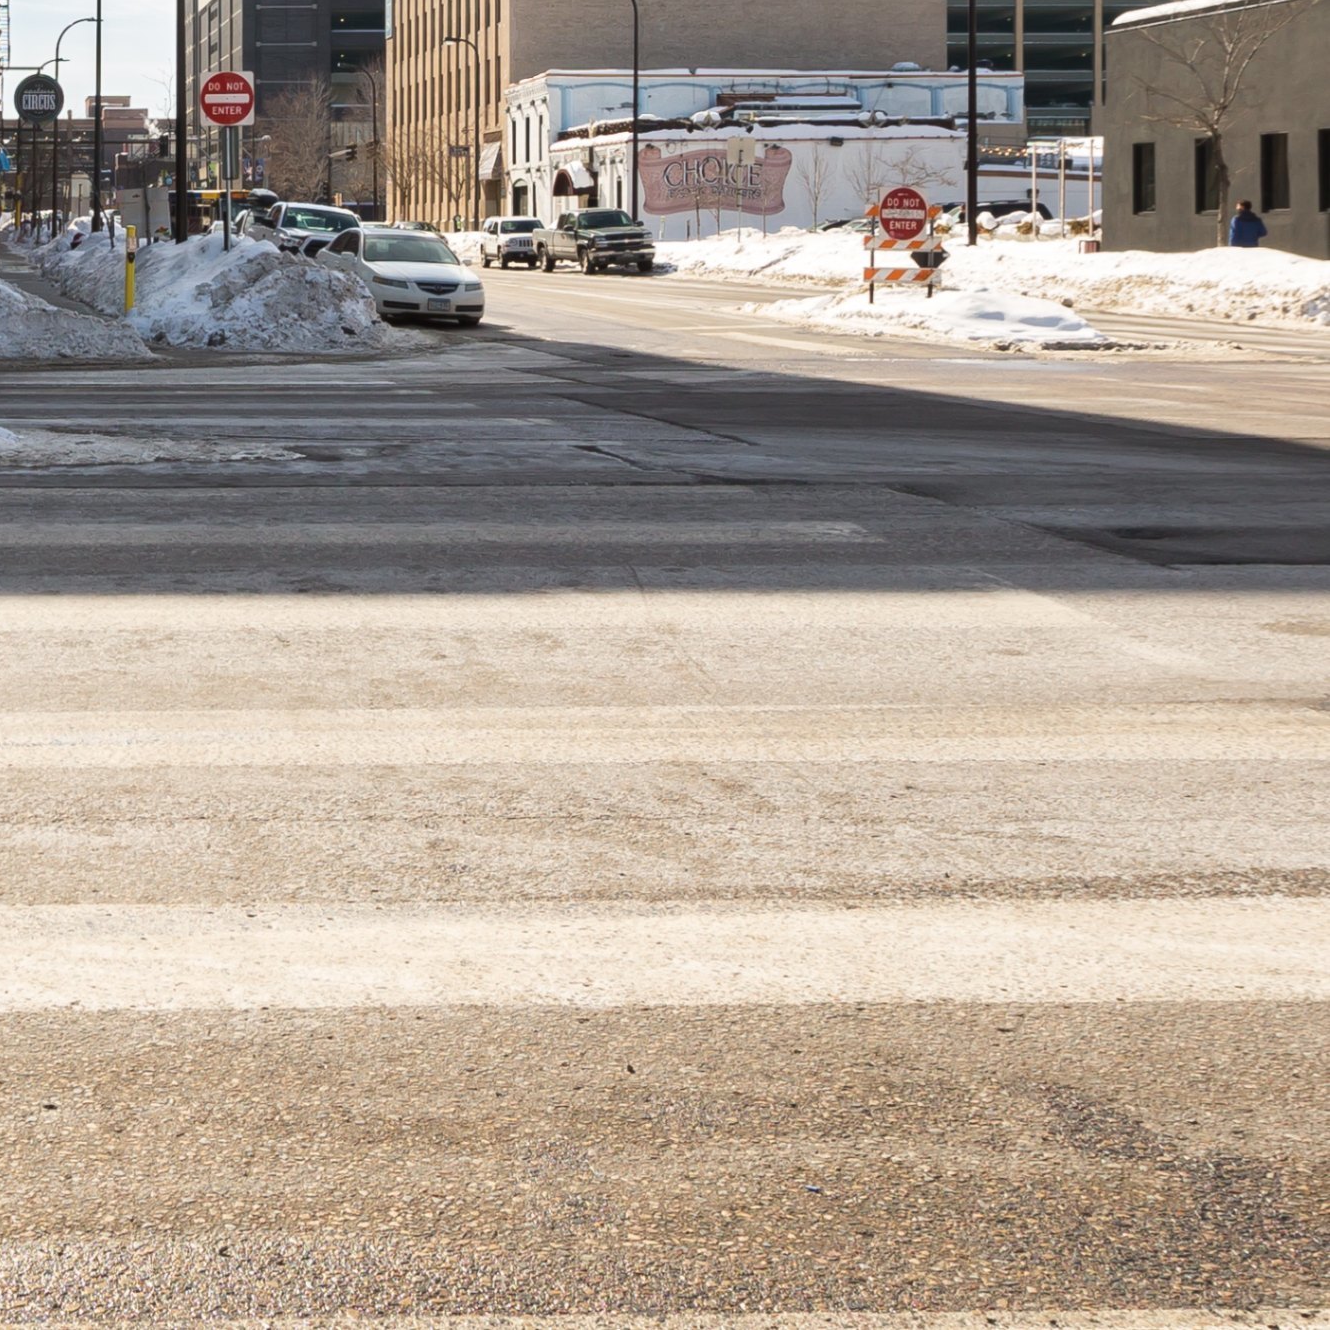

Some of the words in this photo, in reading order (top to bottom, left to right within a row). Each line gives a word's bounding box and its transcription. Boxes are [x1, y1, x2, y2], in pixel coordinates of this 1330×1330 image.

[208, 82, 221, 92] DO
[226, 82, 244, 91] NOT
[22, 94, 56, 110] CIRCUS
[212, 105, 243, 116] ENTER
[663, 156, 764, 188] CHOICE
[887, 197, 900, 207] DO
[902, 198, 920, 208] NOT
[889, 220, 917, 231] ENTER
